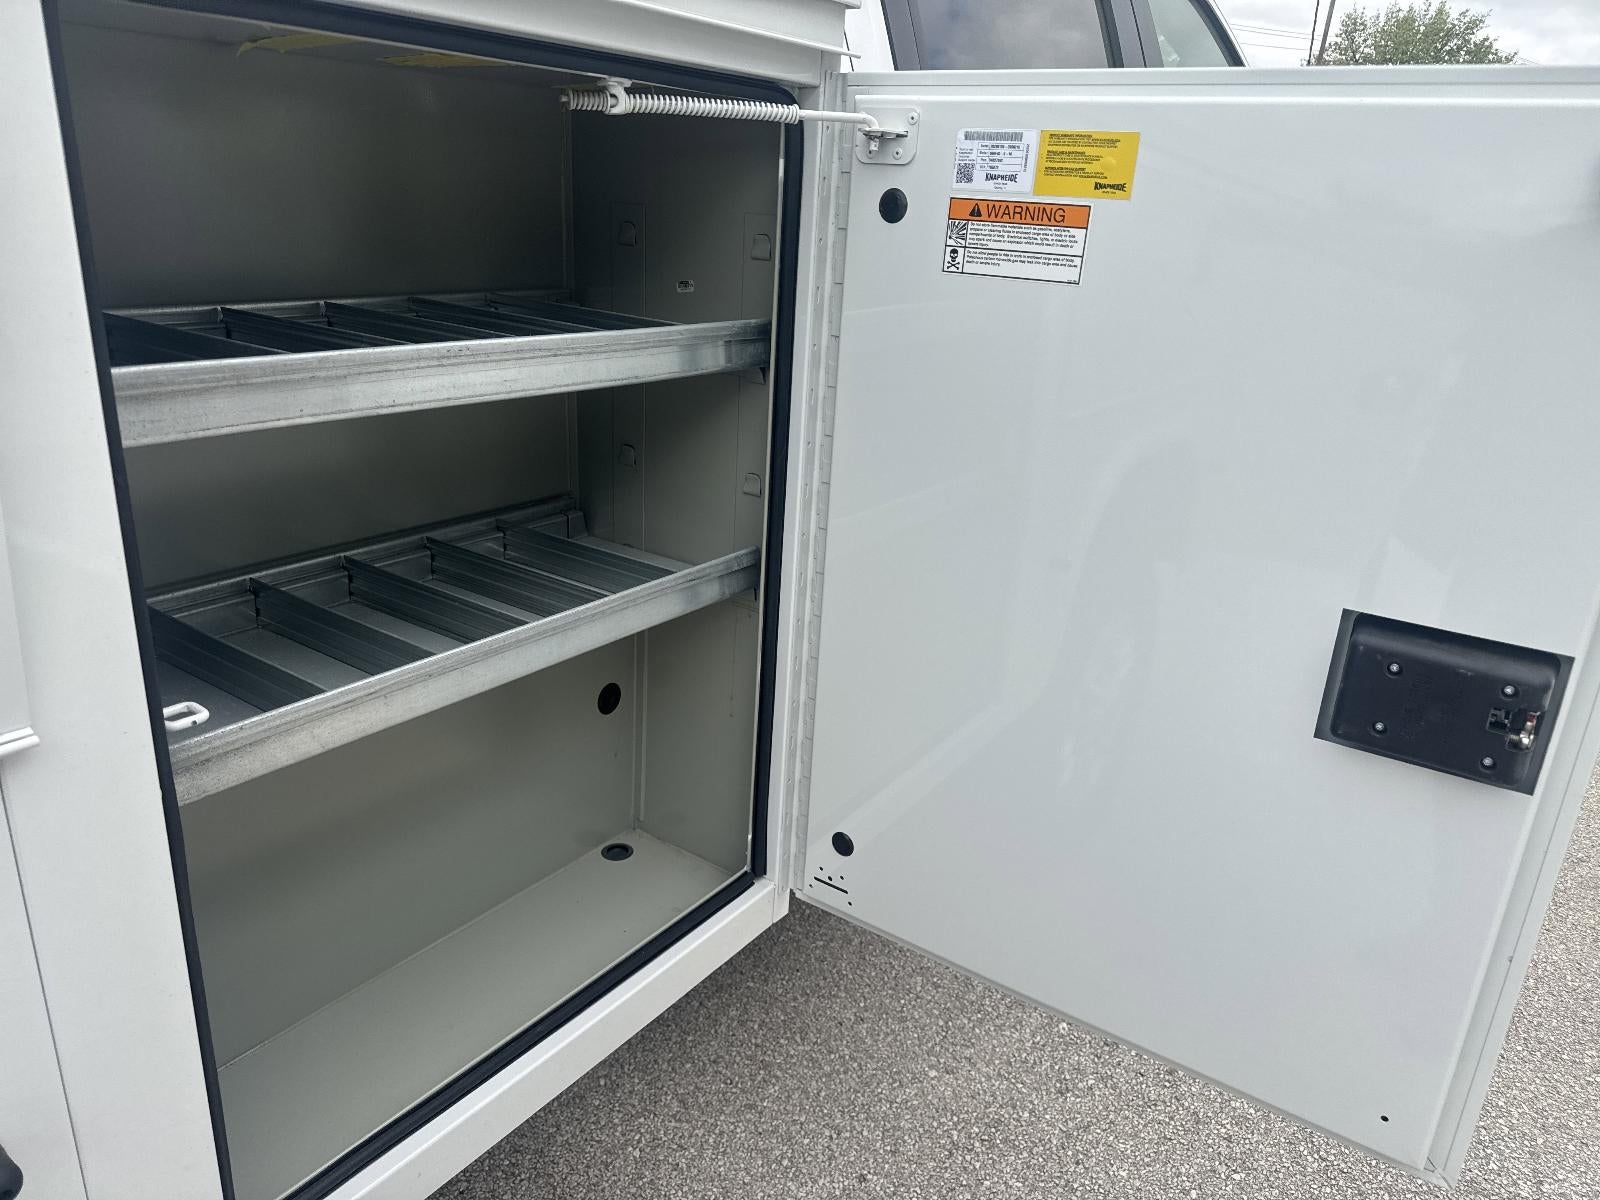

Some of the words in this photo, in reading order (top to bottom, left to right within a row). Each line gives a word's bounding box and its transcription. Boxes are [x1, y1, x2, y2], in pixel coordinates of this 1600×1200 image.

[985, 173, 1018, 183] KNAPHEIDE
[1094, 182, 1126, 192] KNAPHEIDE
[986, 204, 1066, 224] WARNING
